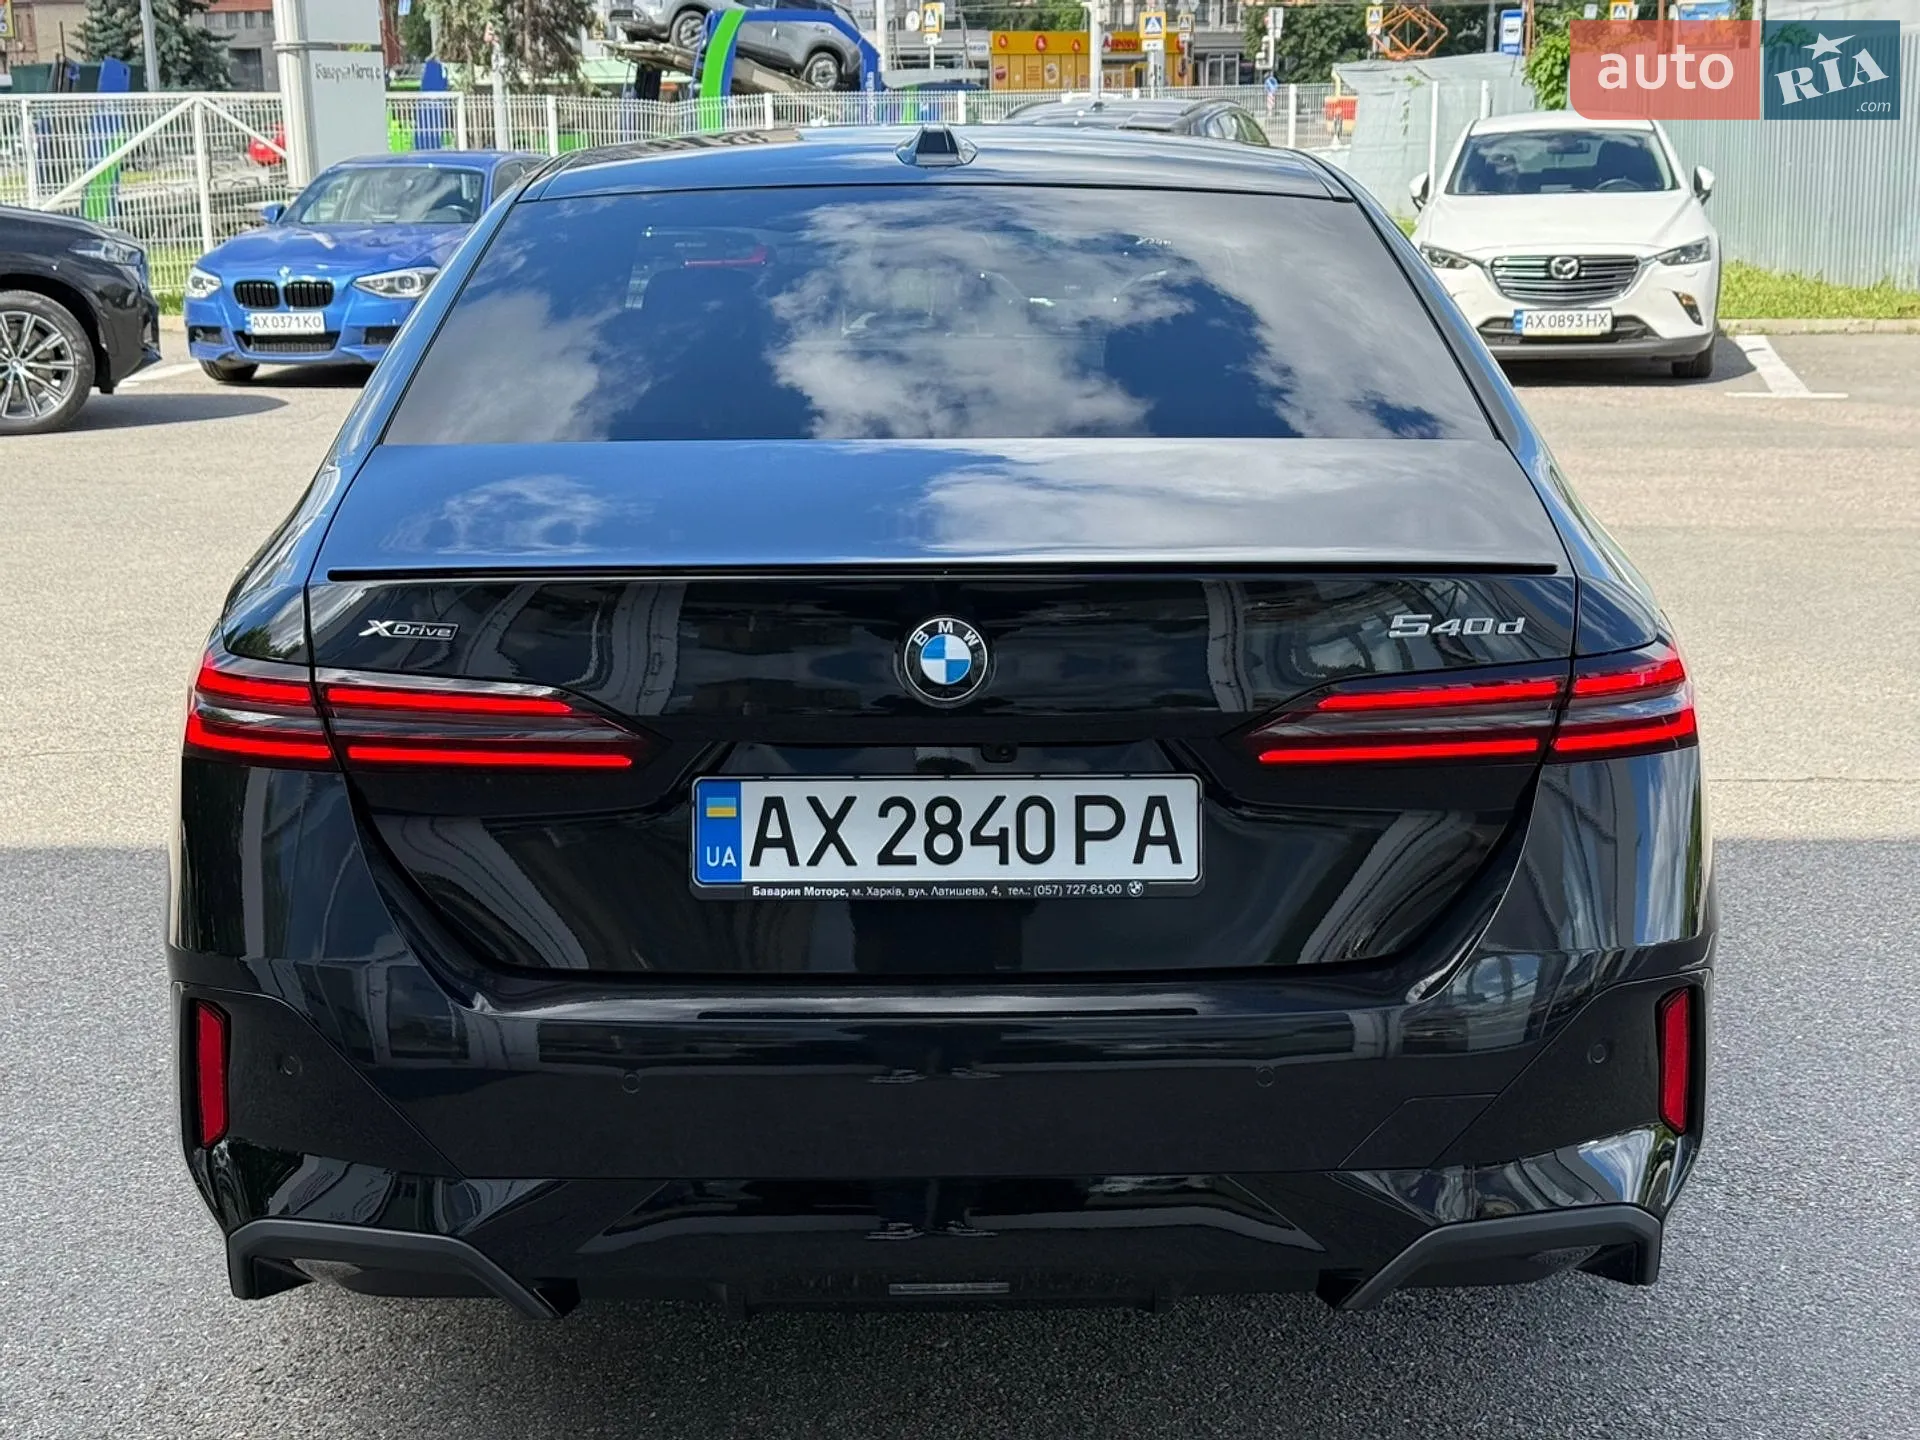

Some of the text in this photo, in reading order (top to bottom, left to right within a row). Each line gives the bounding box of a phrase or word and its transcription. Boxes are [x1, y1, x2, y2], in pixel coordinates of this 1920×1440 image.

[253, 315, 270, 329] AX
[271, 315, 301, 329] 0371
[1525, 313, 1608, 328] AX 0893 HX
[913, 621, 979, 647] BMW
[1388, 614, 1525, 638] 540d
[749, 795, 1183, 867] AX 2840 PA
[706, 846, 737, 867] UA
[752, 885, 801, 898] Бавария
[804, 885, 849, 898] Моторс,
[866, 886, 905, 899] Харків,
[908, 887, 928, 899] вул.
[931, 885, 988, 898] Латишева,
[1033, 884, 1063, 897] (057)
[1066, 884, 1122, 896] 727-61-00
